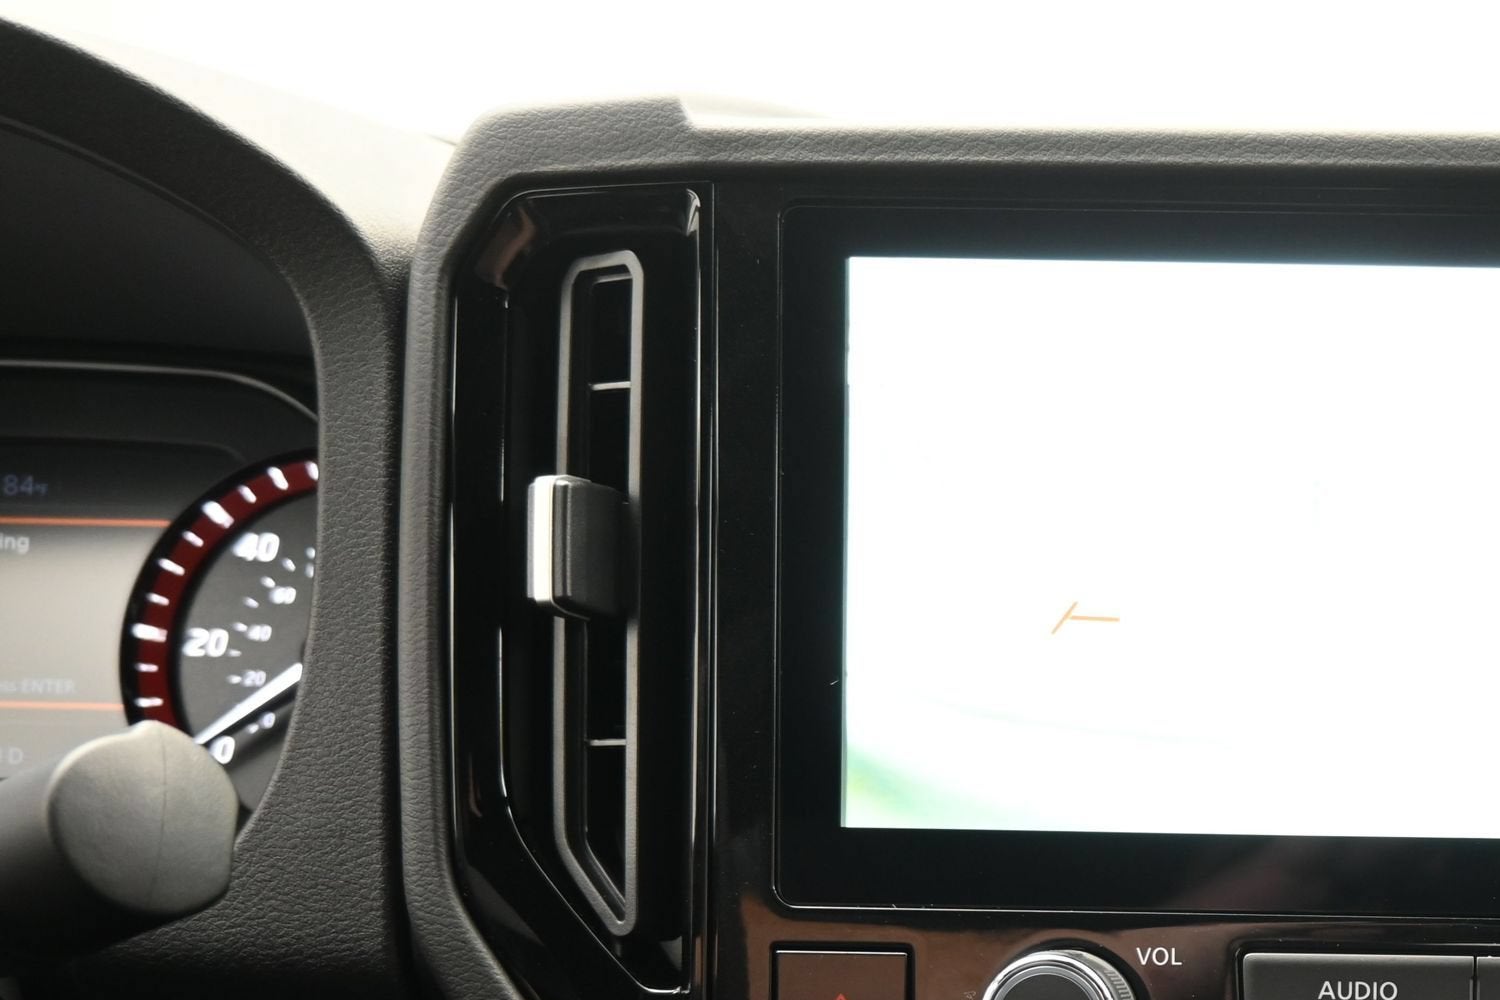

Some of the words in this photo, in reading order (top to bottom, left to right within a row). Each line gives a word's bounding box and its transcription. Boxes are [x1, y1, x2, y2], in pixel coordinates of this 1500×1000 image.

[232, 532, 280, 563] 40
[182, 627, 230, 657] 20
[242, 670, 267, 687] 20
[208, 735, 236, 764] 0
[1136, 947, 1183, 966] VOL
[1317, 980, 1398, 1000] AUDIO
